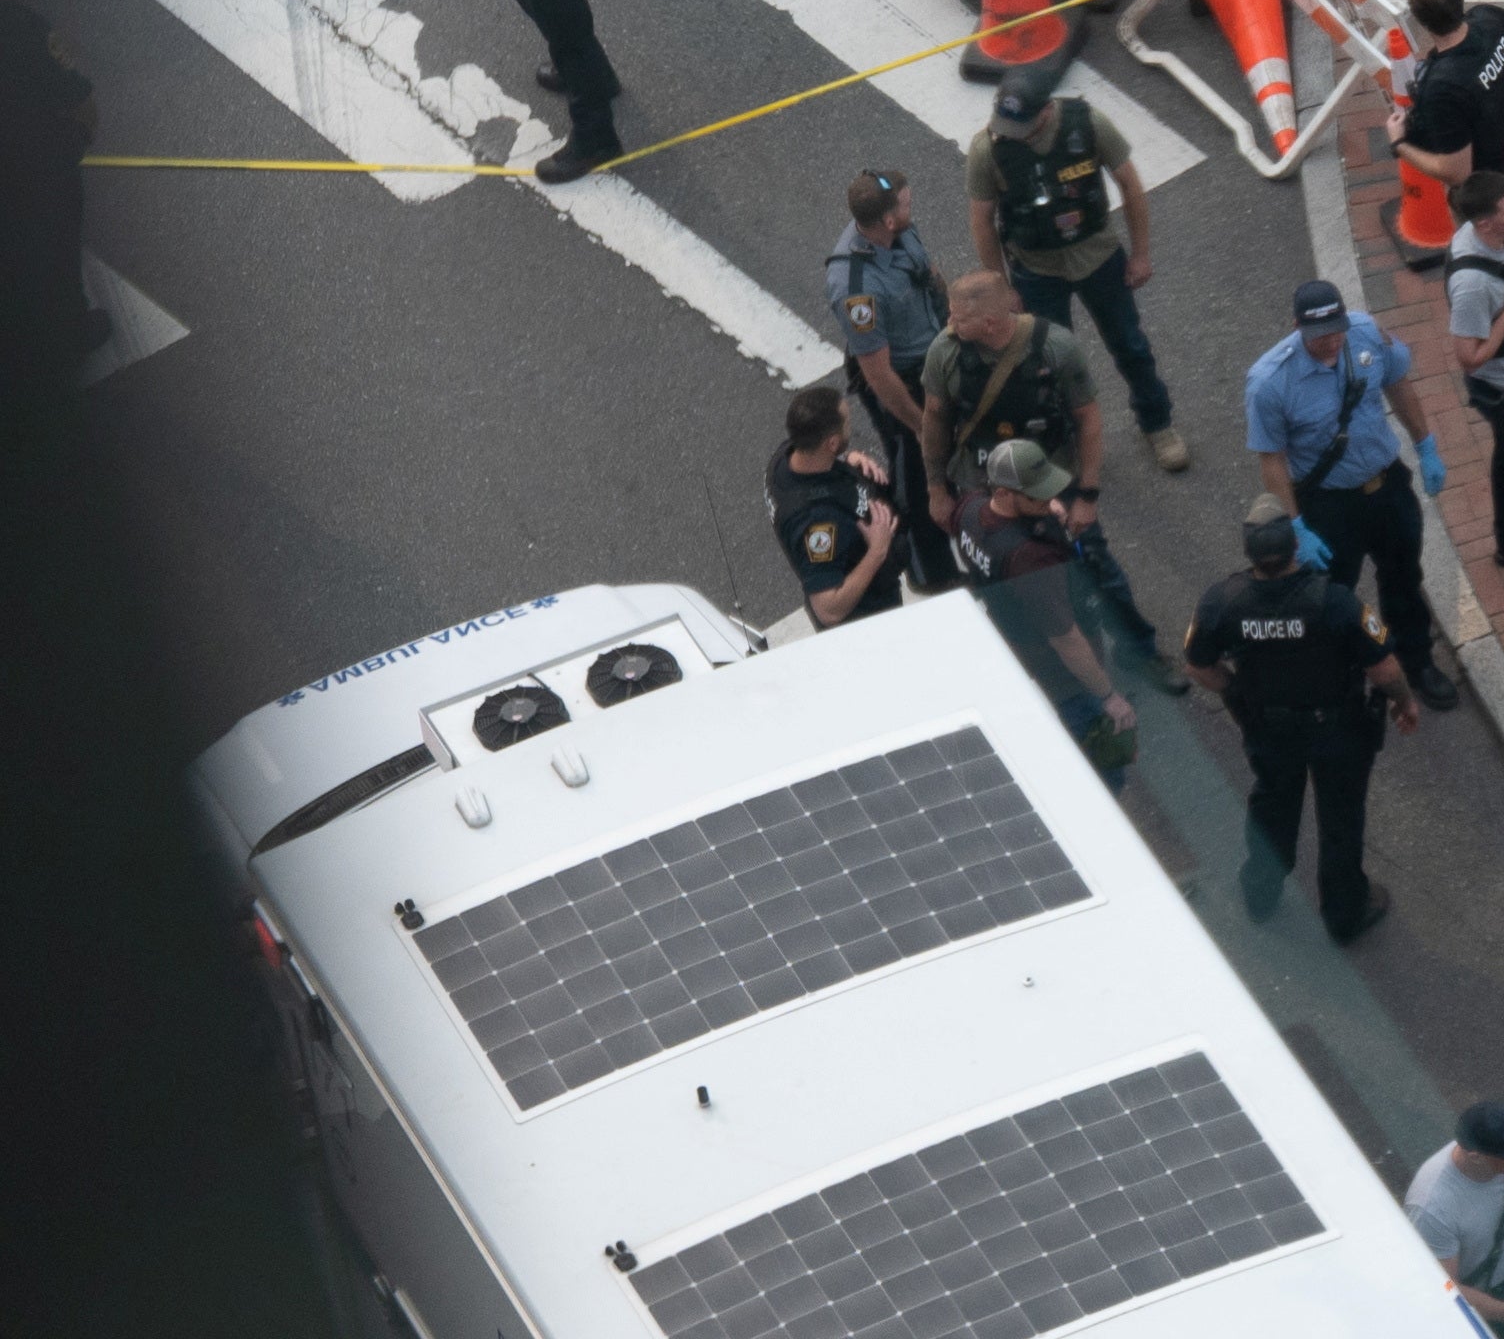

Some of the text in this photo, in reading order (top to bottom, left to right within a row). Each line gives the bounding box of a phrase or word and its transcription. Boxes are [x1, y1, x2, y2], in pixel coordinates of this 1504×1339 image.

[1056, 160, 1096, 183] POLICE
[959, 530, 990, 577] POLICE
[1241, 618, 1303, 639] POLICE K9
